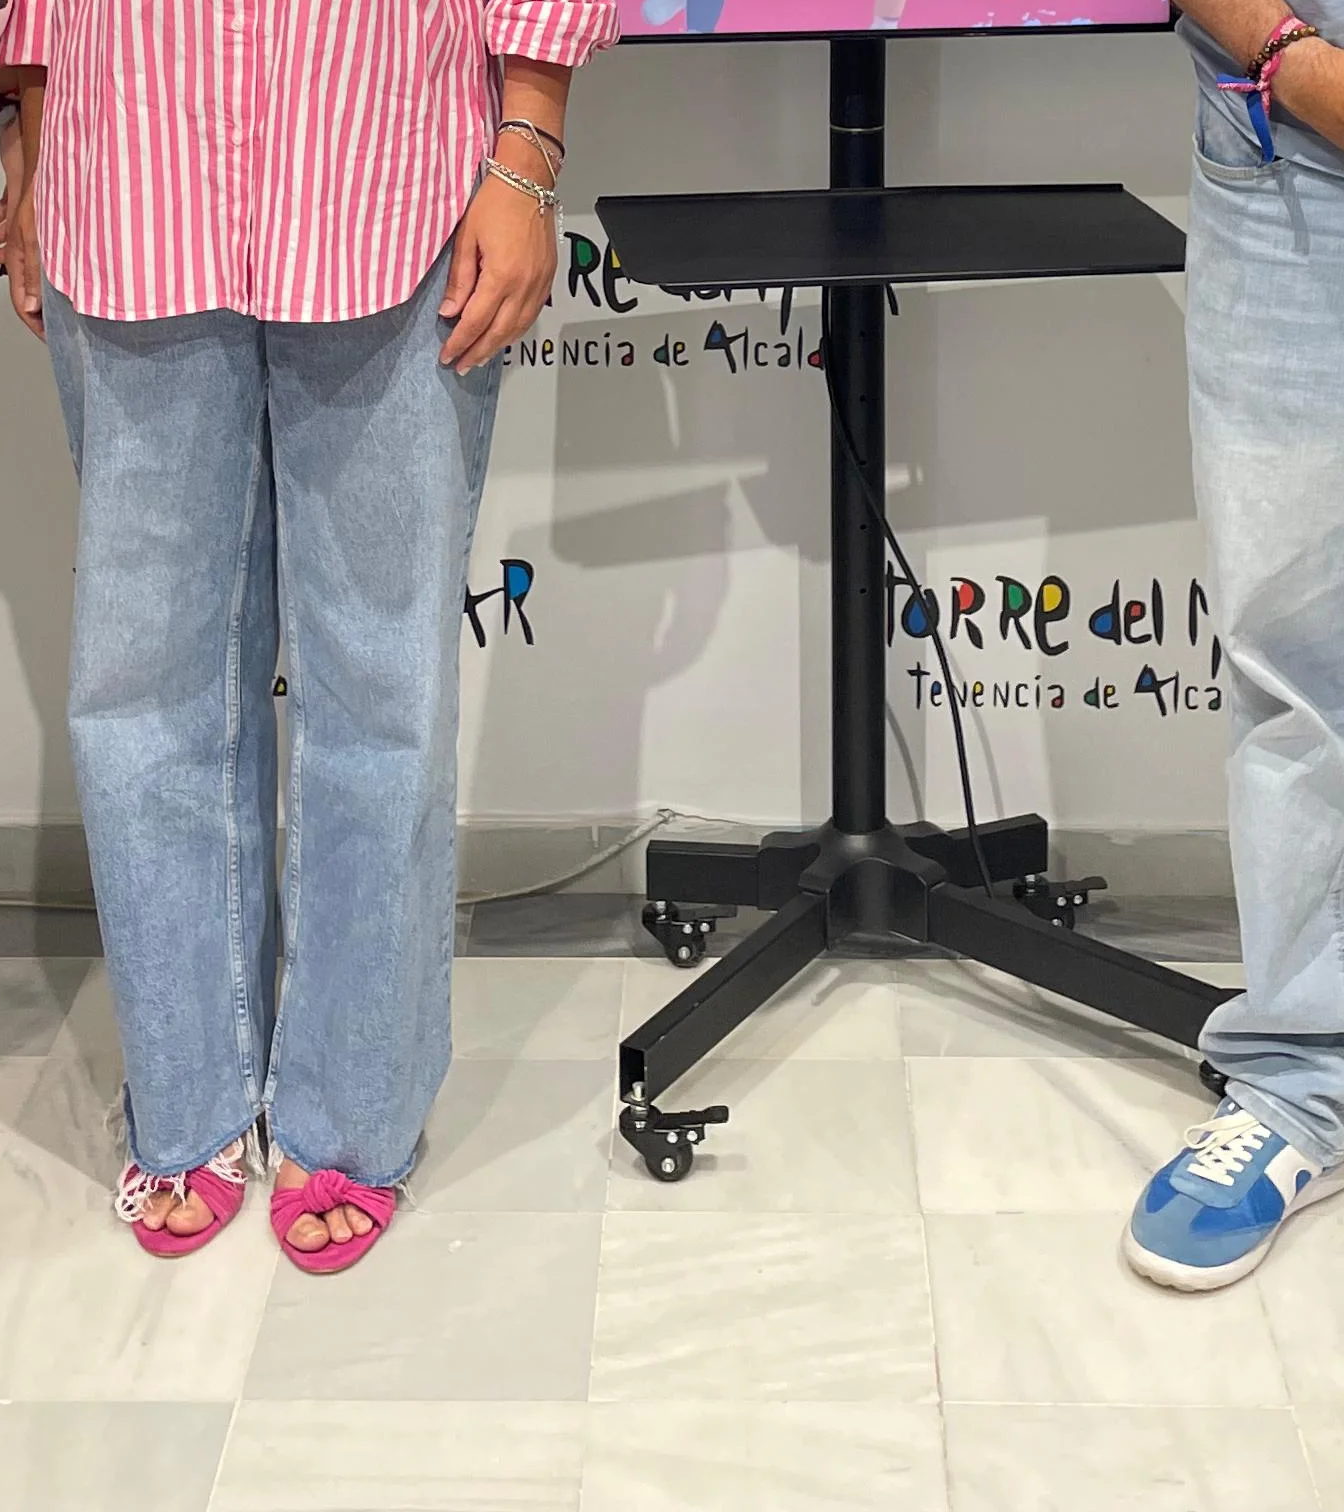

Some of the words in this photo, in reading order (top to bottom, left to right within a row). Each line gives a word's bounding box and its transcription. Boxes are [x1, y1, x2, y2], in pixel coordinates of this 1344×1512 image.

[653, 333, 691, 369] de
[1089, 578, 1162, 646] del
[1083, 677, 1120, 709] de
